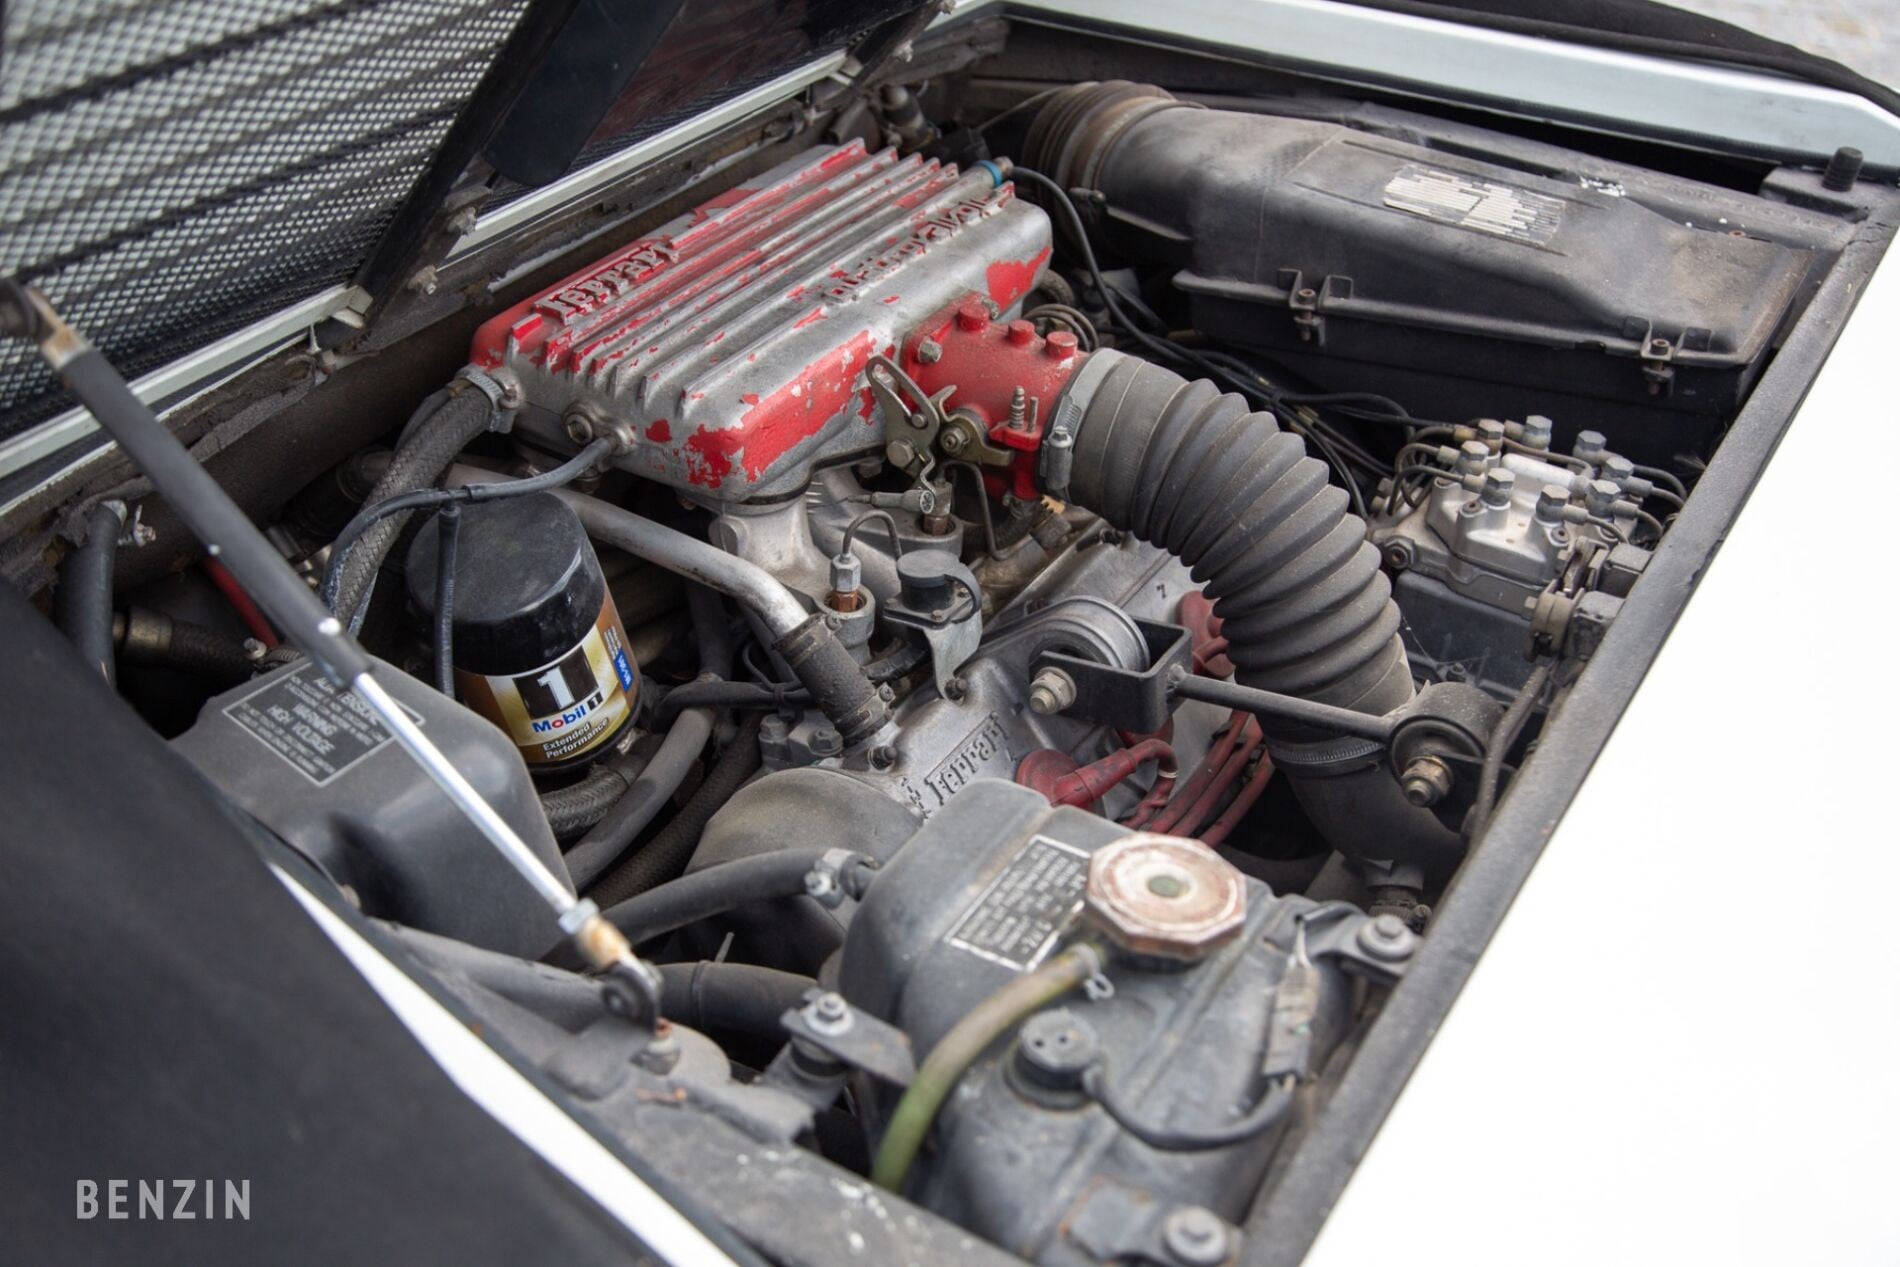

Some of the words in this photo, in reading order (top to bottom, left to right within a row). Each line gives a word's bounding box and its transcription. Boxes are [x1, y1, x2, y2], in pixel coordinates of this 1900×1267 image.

[534, 242, 679, 326] Ferrari
[537, 666, 575, 710] 1
[531, 705, 587, 733] Mobil
[543, 721, 591, 751] Extended
[546, 717, 610, 759] Performance
[924, 711, 1009, 807] Ferrari
